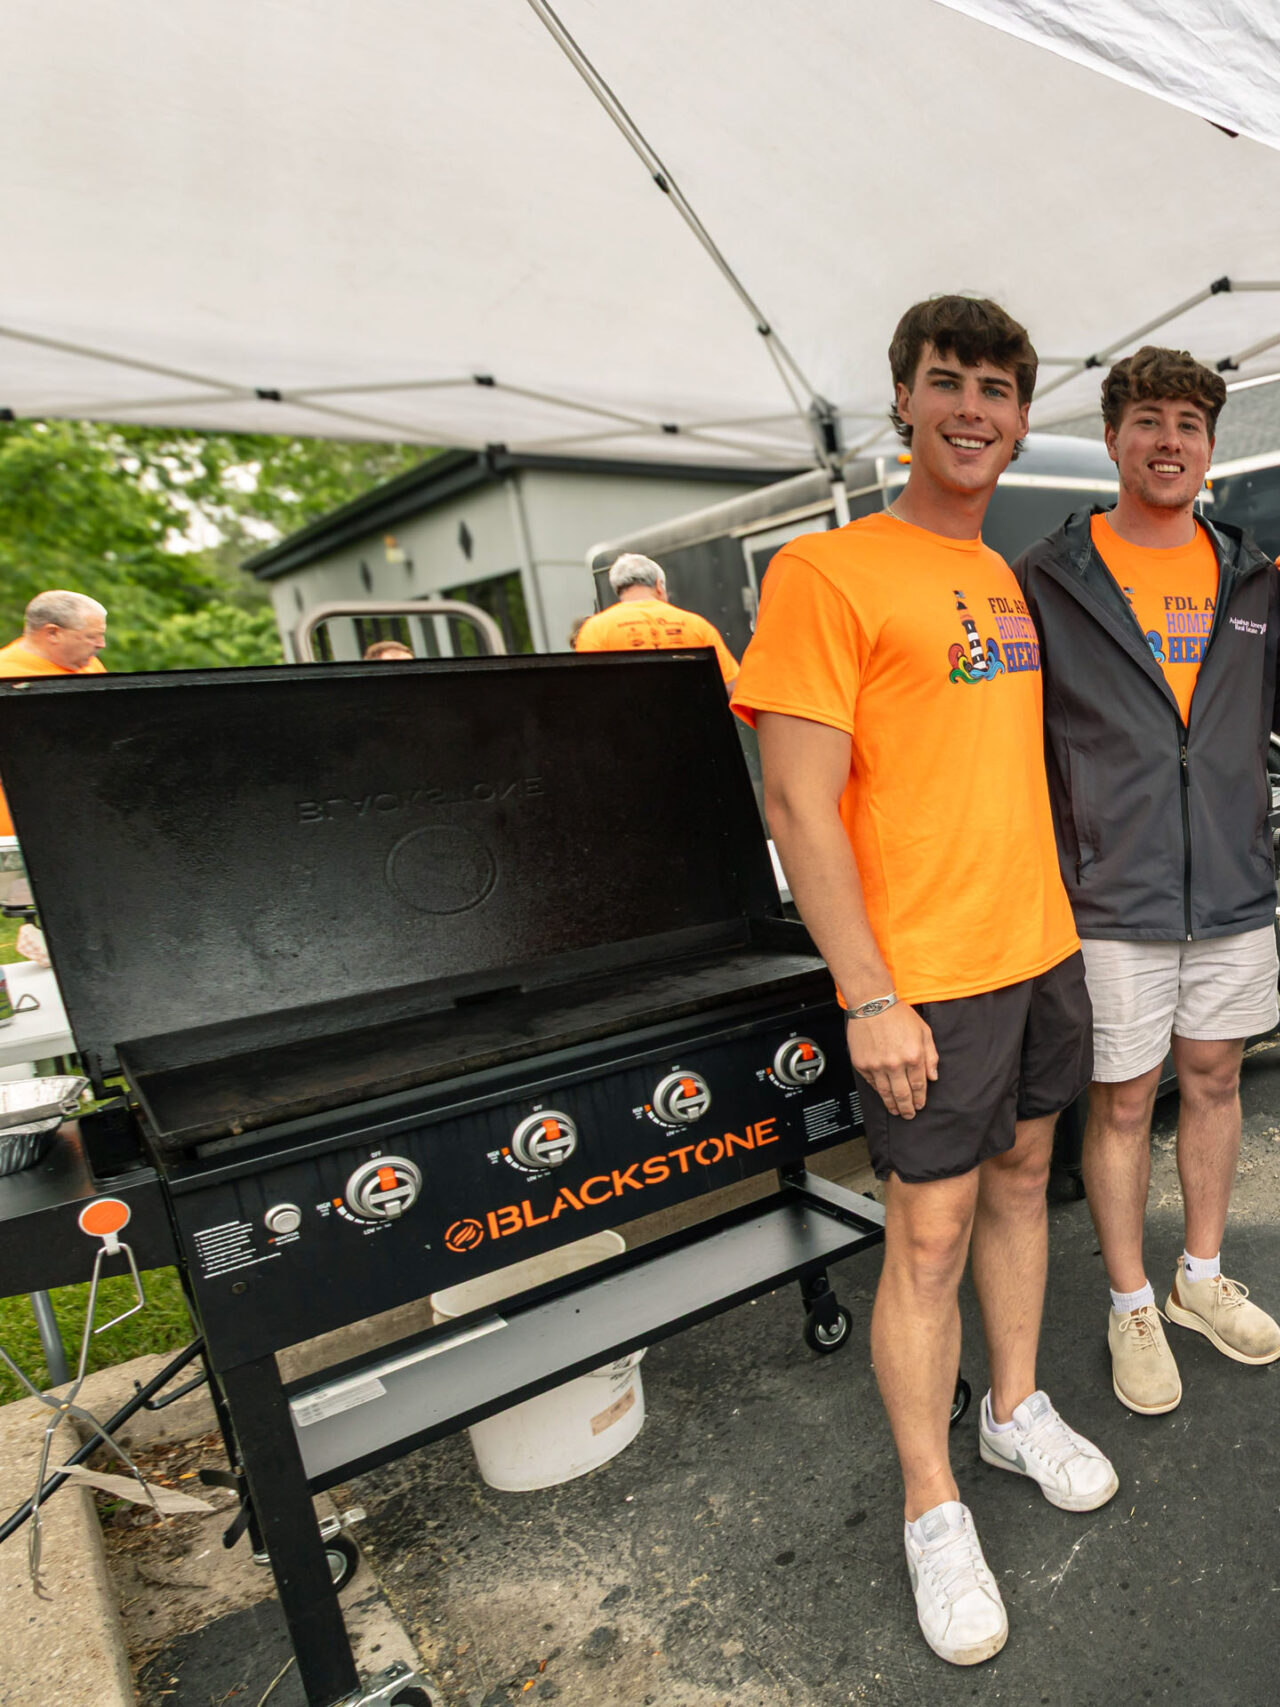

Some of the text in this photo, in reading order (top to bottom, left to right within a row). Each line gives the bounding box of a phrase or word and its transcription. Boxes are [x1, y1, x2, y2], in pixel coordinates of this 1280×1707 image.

[988, 597, 1014, 614] FDL
[1163, 596, 1198, 611] FDL
[1165, 613, 1213, 633] HOME
[1002, 641, 1040, 673] HERO
[486, 1117, 780, 1240] BLACKSTONE
